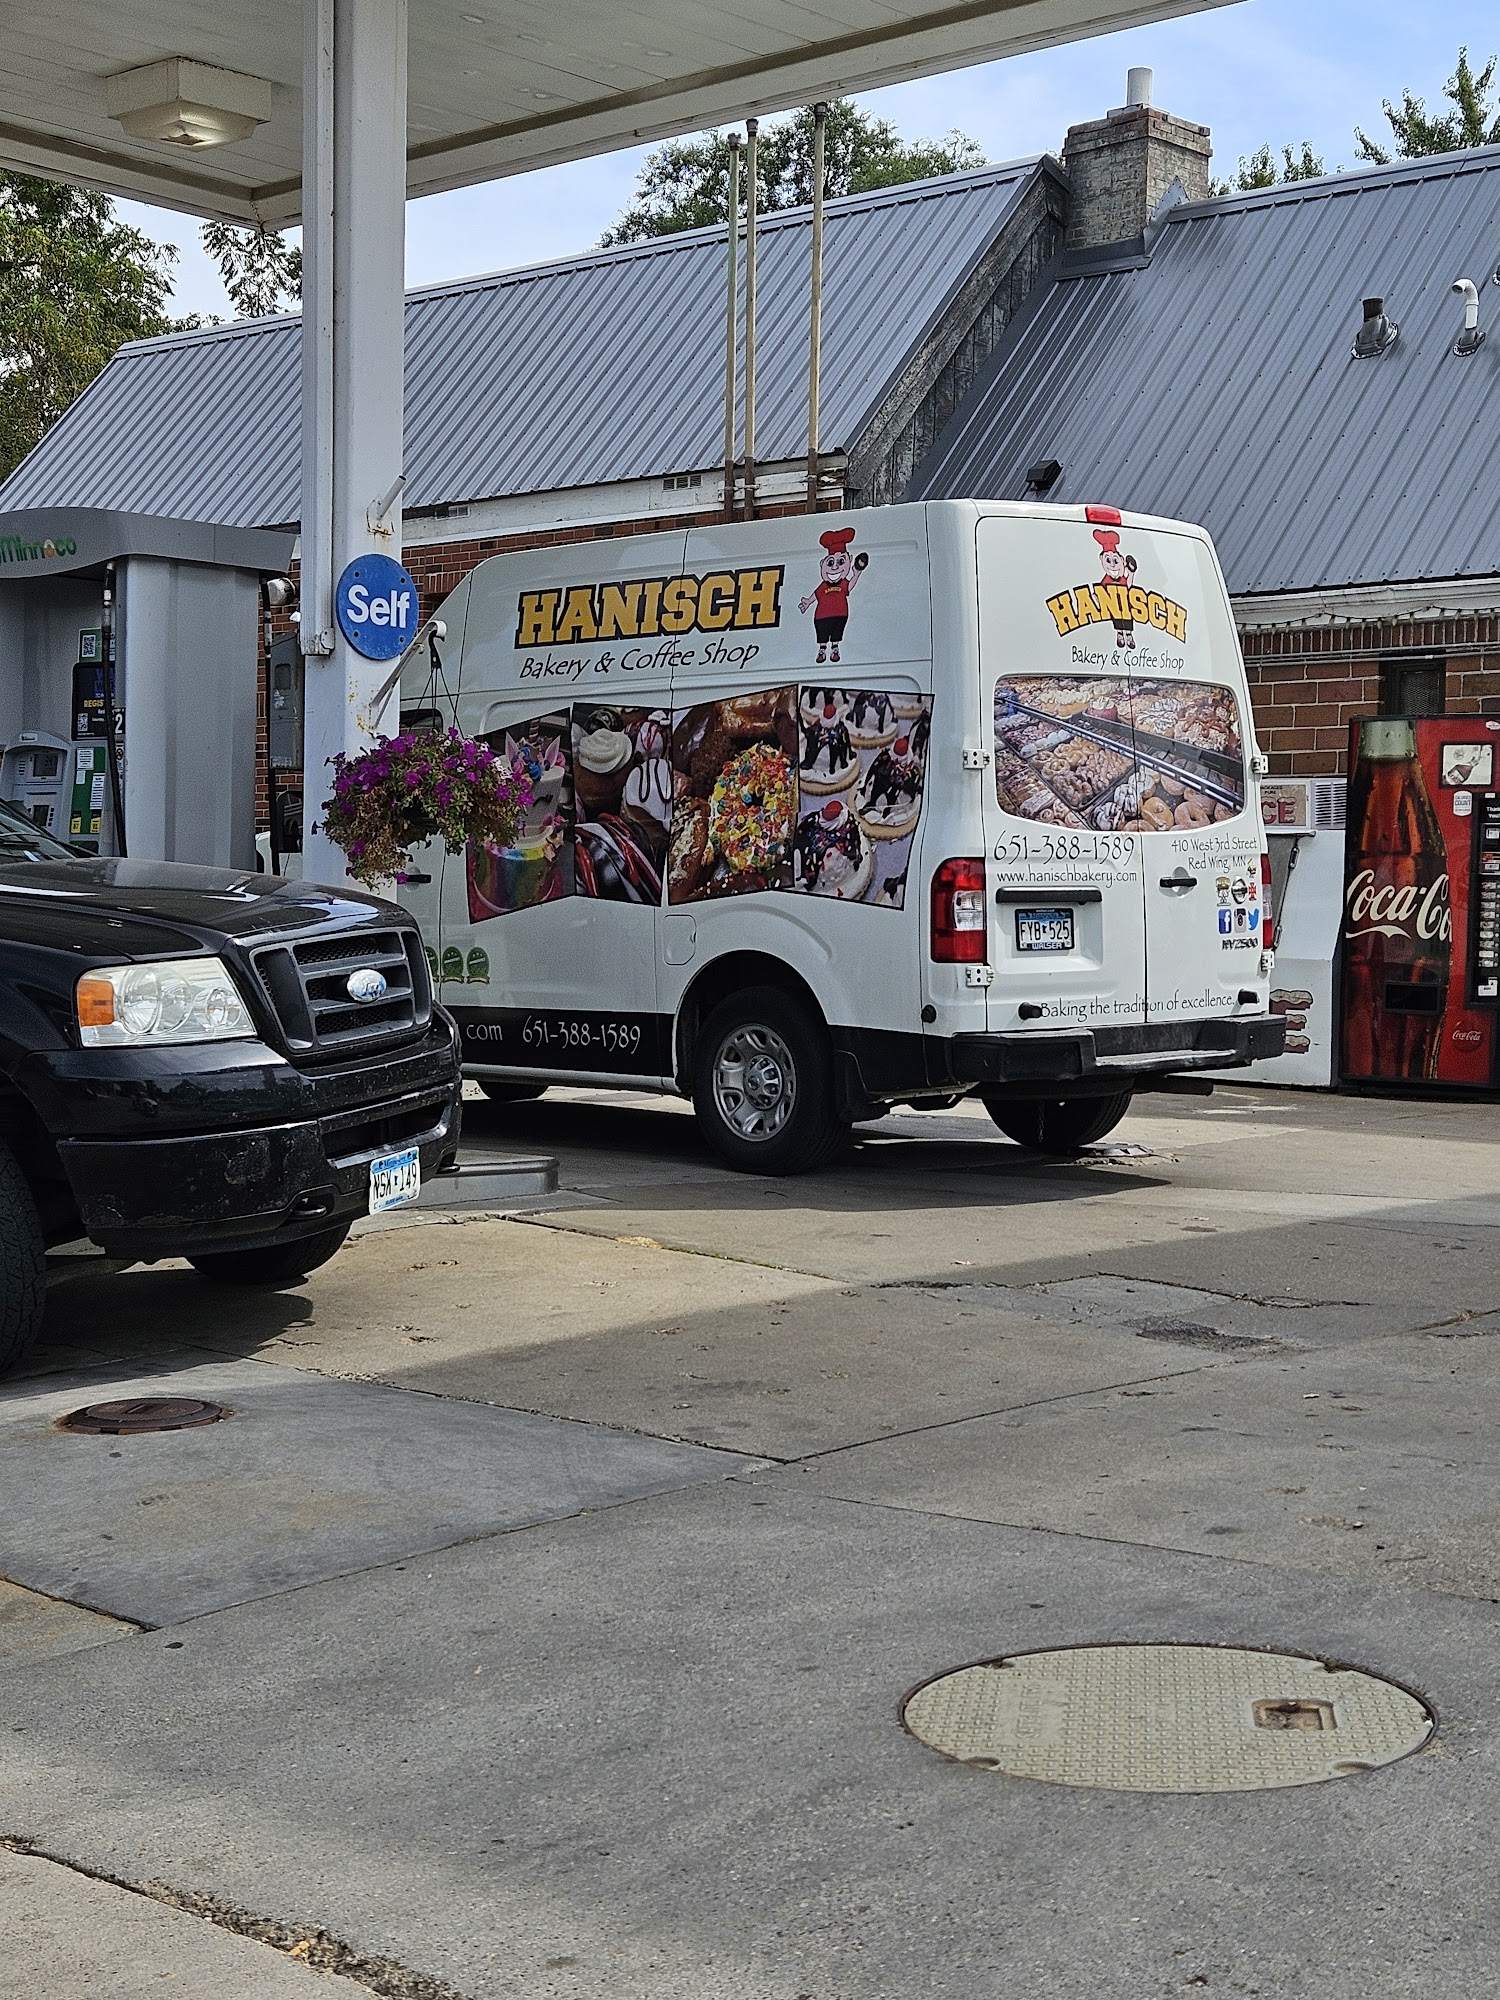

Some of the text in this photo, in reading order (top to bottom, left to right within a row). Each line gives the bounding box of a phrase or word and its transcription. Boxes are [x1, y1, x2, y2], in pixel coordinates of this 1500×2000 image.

[346, 584, 411, 629] Self
[515, 565, 785, 649] HANISCH
[1046, 583, 1187, 644] HANISCH
[519, 638, 760, 681] Bakery & Coffee Shop
[1071, 646, 1184, 675] Bakery & Coffee Shop
[114, 713, 123, 734] 2
[1260, 796, 1297, 825] CE
[994, 830, 1135, 866] 651-388-1589
[1171, 832, 1258, 852] 410 West 3rd Street
[996, 863, 1137, 888] www.hanischbakery.com
[1188, 852, 1247, 873] Red Wing, MN
[1020, 920, 1070, 941] FYB 525
[1221, 937, 1259, 950] NV2500
[1031, 942, 1063, 950] WALSER
[1040, 988, 1235, 1022] Baking the tradition of excellence.
[522, 1015, 641, 1054] 651-388-1589
[400, 1162, 417, 1191] 149
